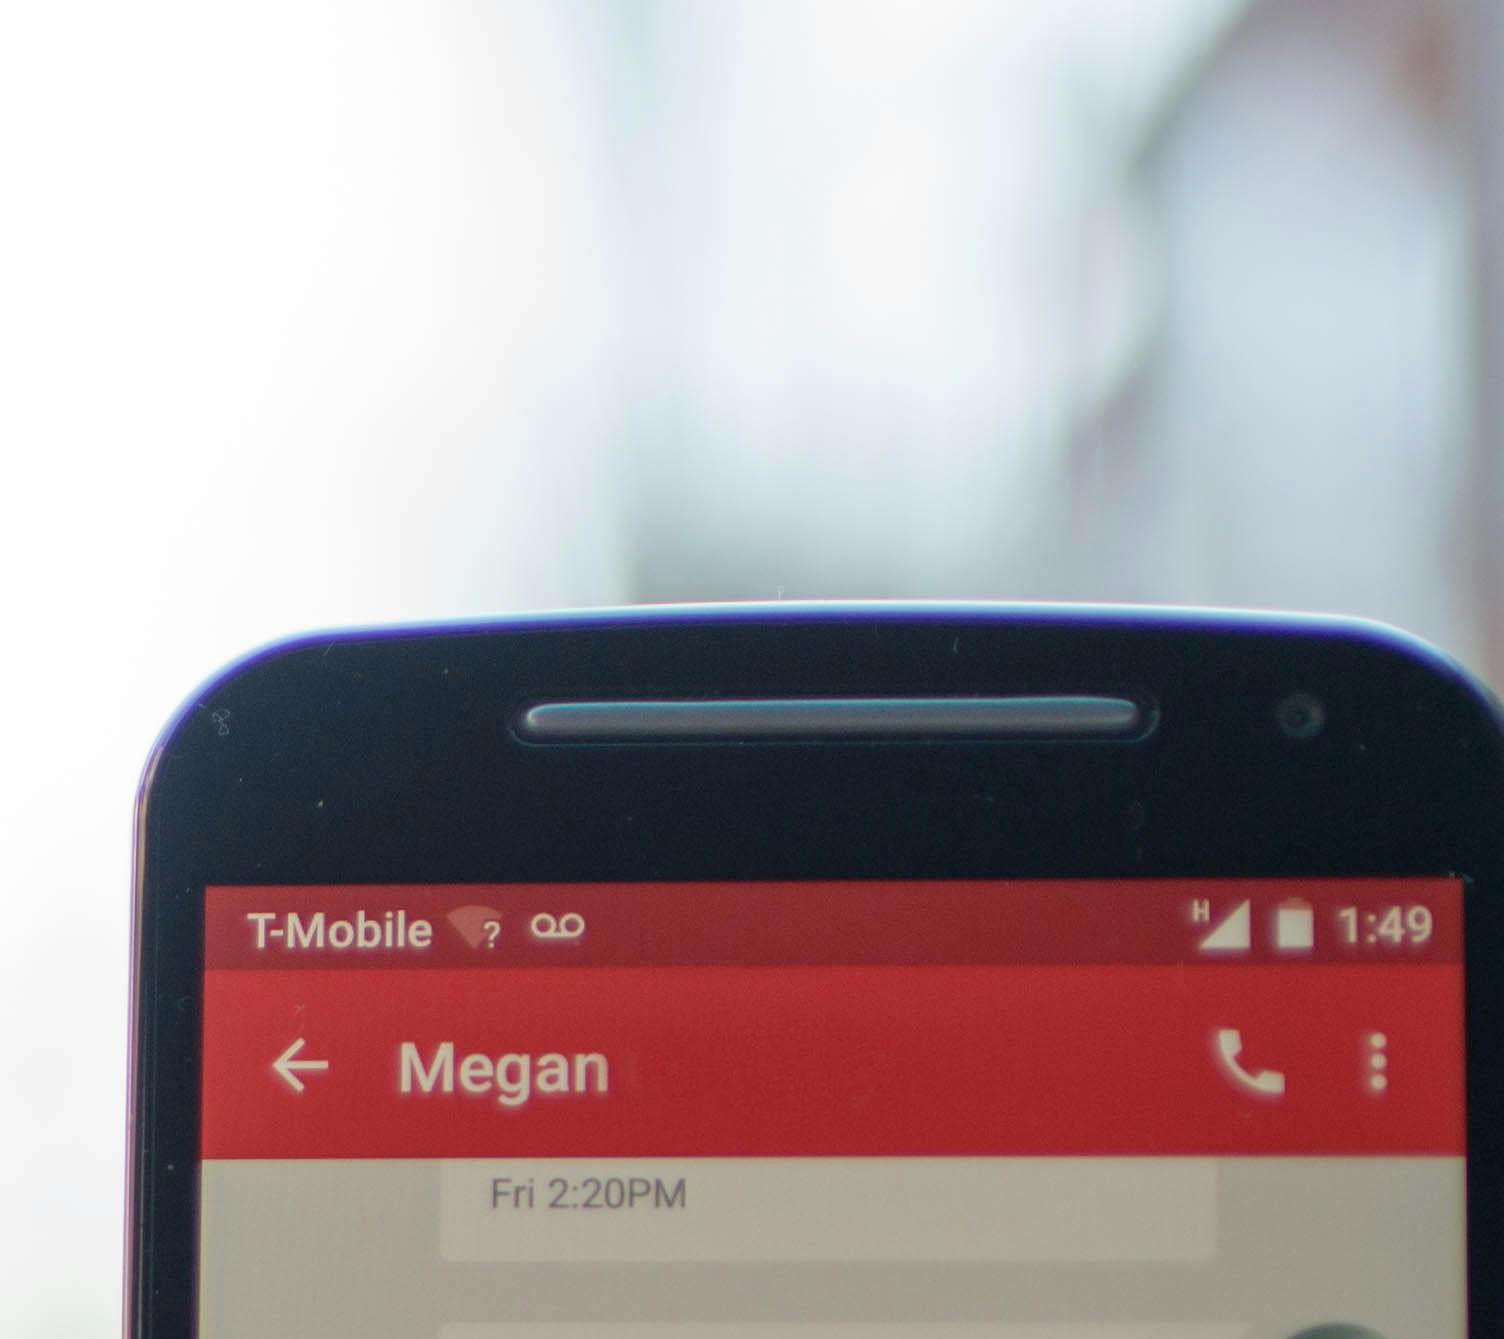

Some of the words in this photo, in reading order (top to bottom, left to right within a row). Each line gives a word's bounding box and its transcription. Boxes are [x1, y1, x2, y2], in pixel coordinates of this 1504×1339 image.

[248, 911, 433, 950] T-Mobile
[1337, 907, 1432, 944] 1:49
[400, 1041, 608, 1105] Megan
[492, 1178, 533, 1209] Fri
[548, 1178, 686, 1209] 2:20PM
